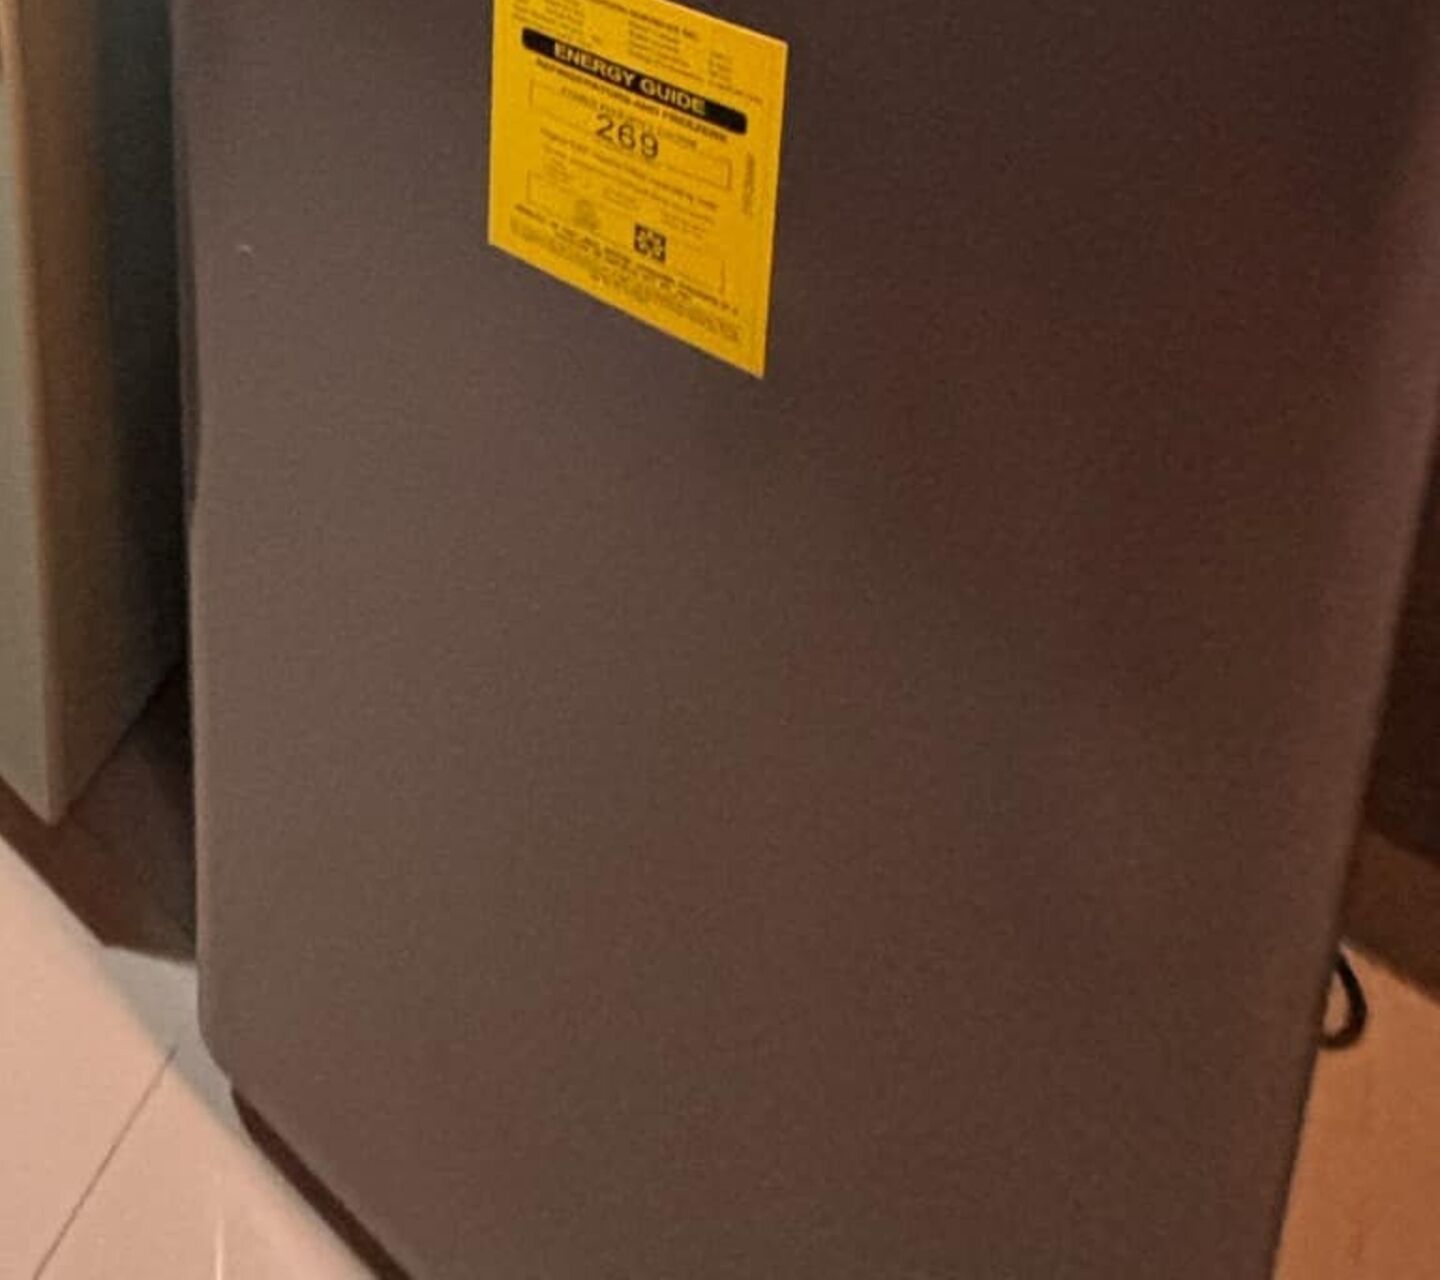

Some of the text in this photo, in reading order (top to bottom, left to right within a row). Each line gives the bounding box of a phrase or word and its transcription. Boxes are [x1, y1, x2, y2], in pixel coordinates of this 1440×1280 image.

[553, 41, 637, 88] ENERGY
[639, 76, 707, 116] GUIDE
[594, 112, 660, 161] 269
